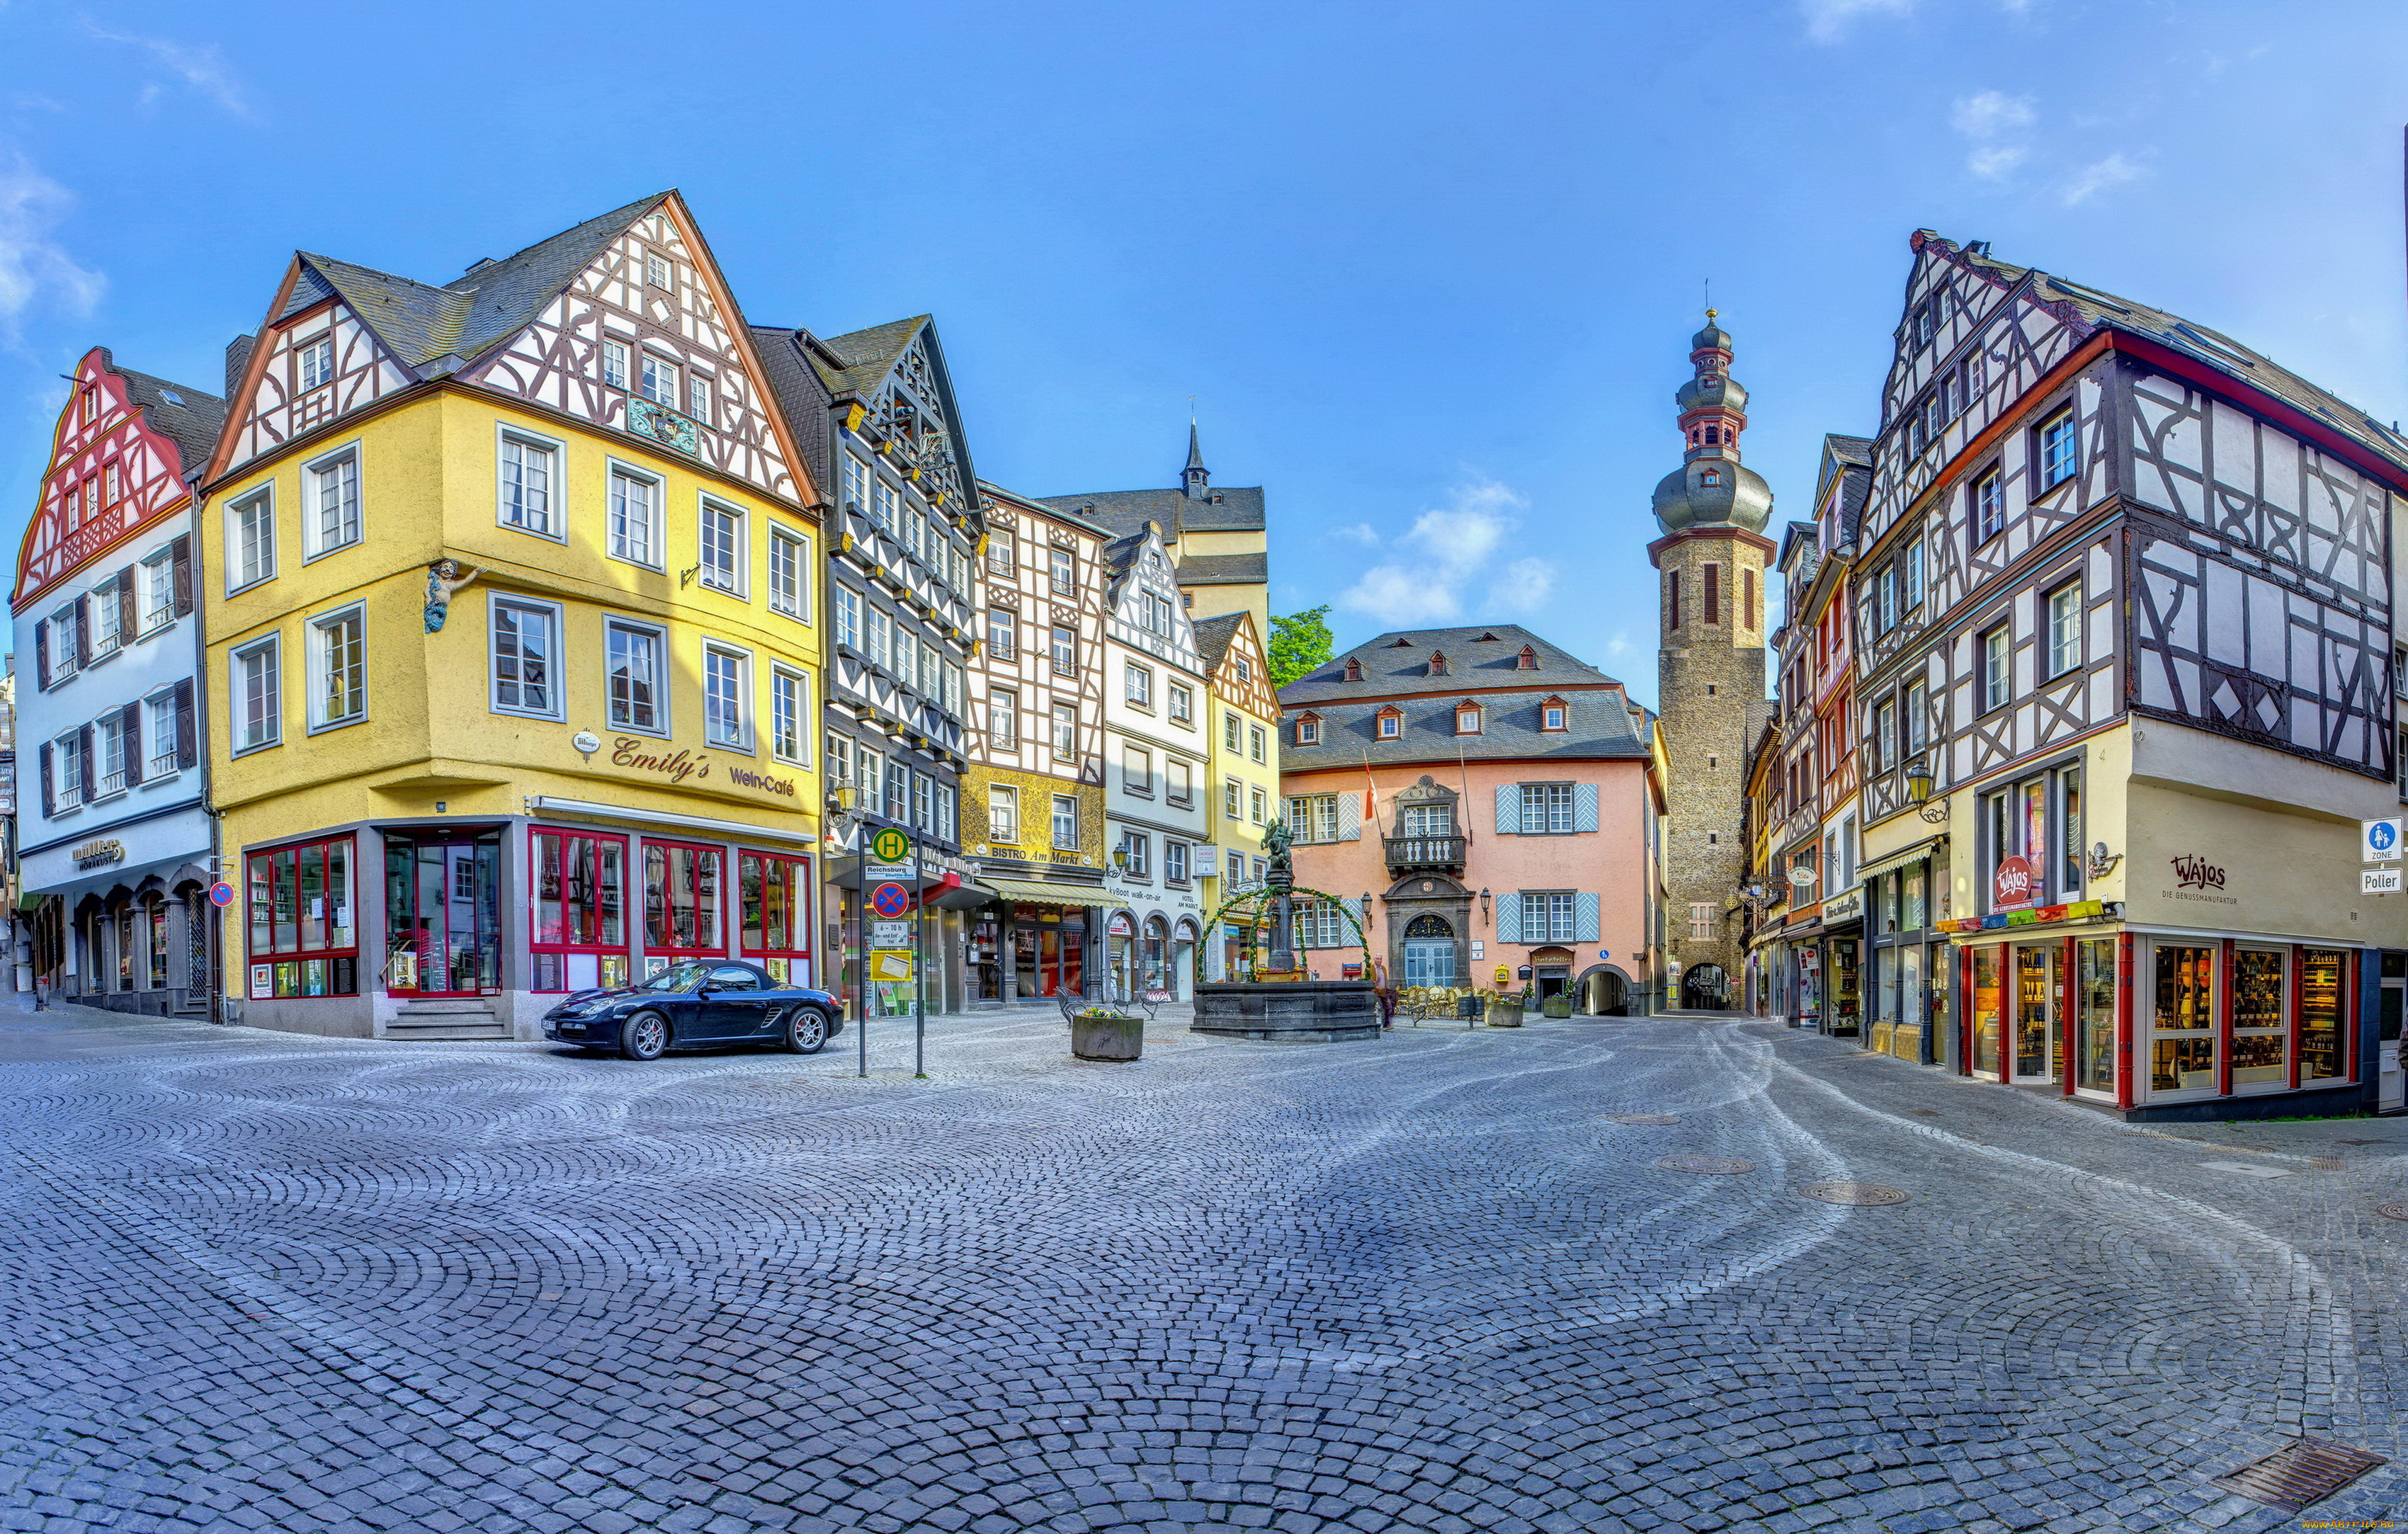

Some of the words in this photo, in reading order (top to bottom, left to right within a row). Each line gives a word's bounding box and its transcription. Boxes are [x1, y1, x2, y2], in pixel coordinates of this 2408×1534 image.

[729, 766, 794, 797] Wein-Café
[883, 836, 898, 855] H
[79, 856, 119, 872] HÖRAKUSTI
[992, 847, 1026, 859] BISTRO
[1030, 850, 1047, 861] Am
[1050, 851, 1079, 865] Markt
[1131, 891, 1161, 901] walk-on-air
[2176, 892, 2238, 905] GENUSSMANUFAKTUR
